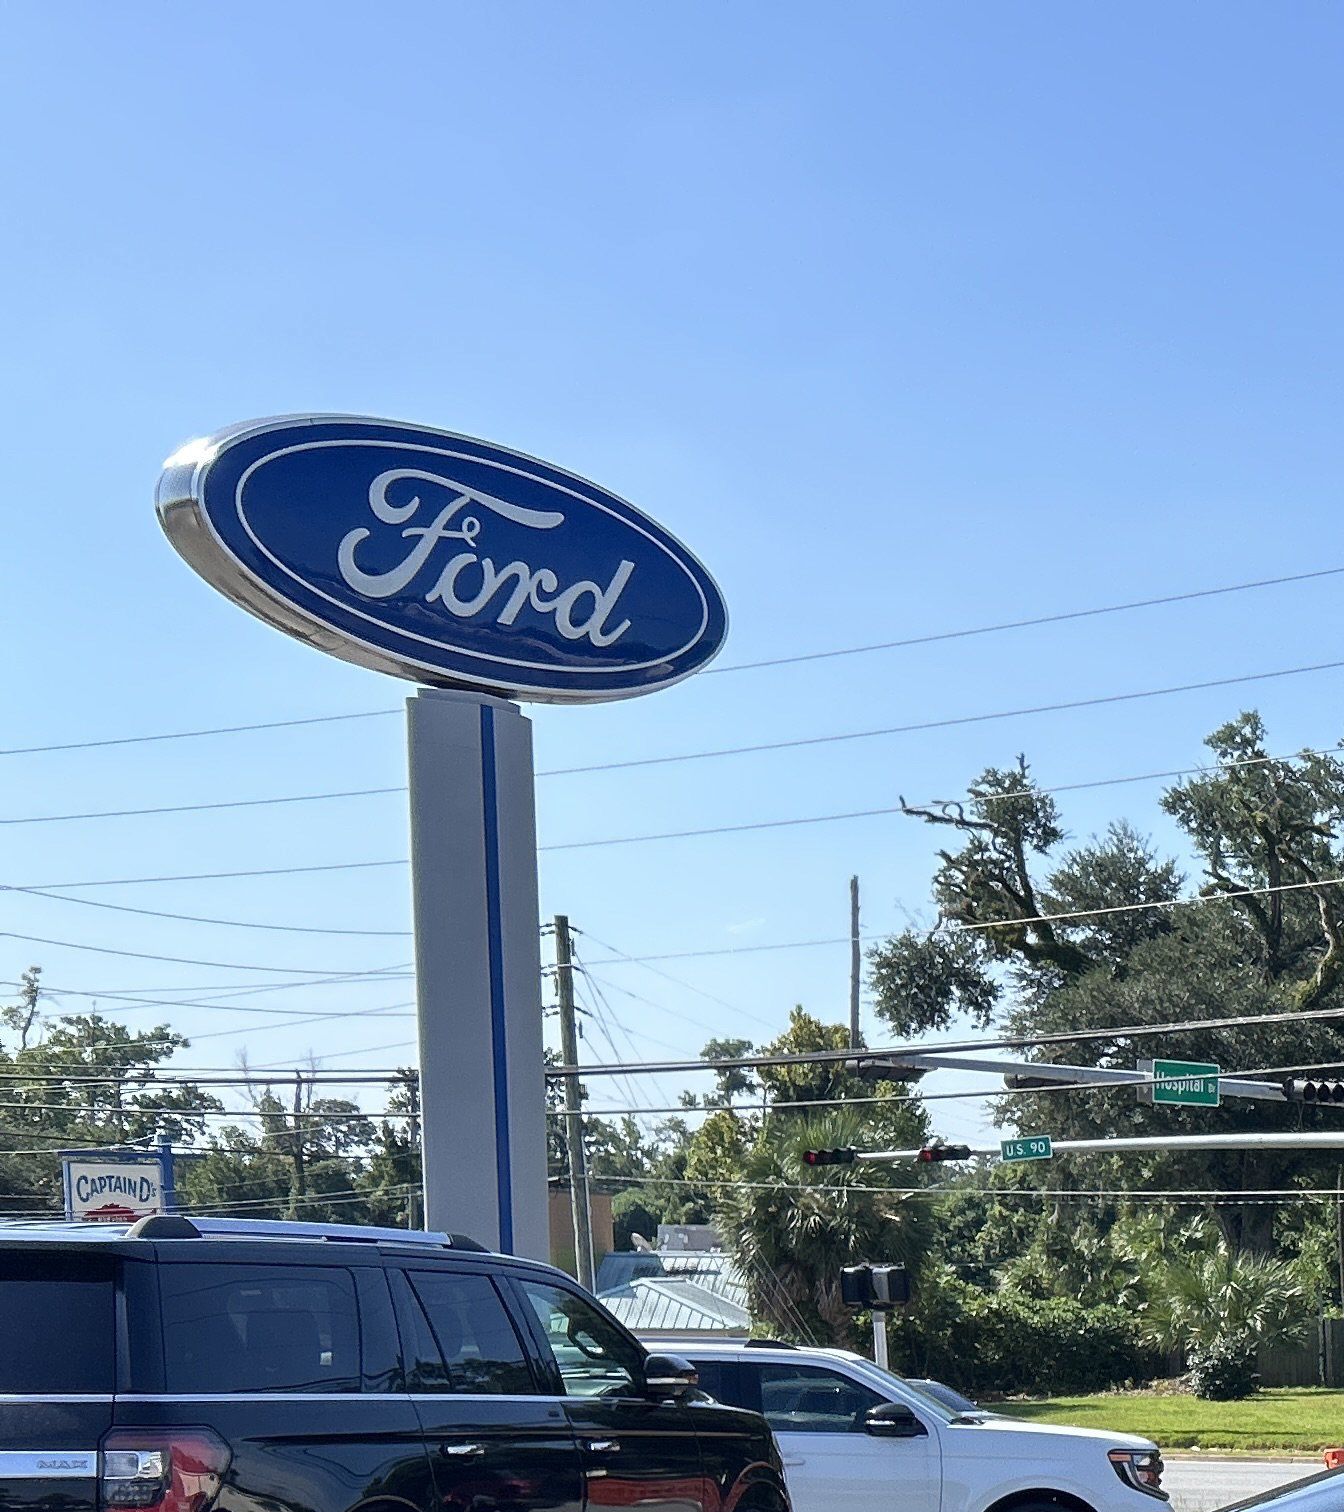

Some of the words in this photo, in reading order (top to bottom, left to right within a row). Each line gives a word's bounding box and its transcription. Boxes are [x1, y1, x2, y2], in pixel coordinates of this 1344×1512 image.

[337, 467, 636, 648] Ford
[1155, 1069, 1204, 1095] Hospital
[1006, 1144, 1027, 1157] U.S.
[1030, 1141, 1046, 1154] 90
[75, 1174, 137, 1203] CAPTAIN
